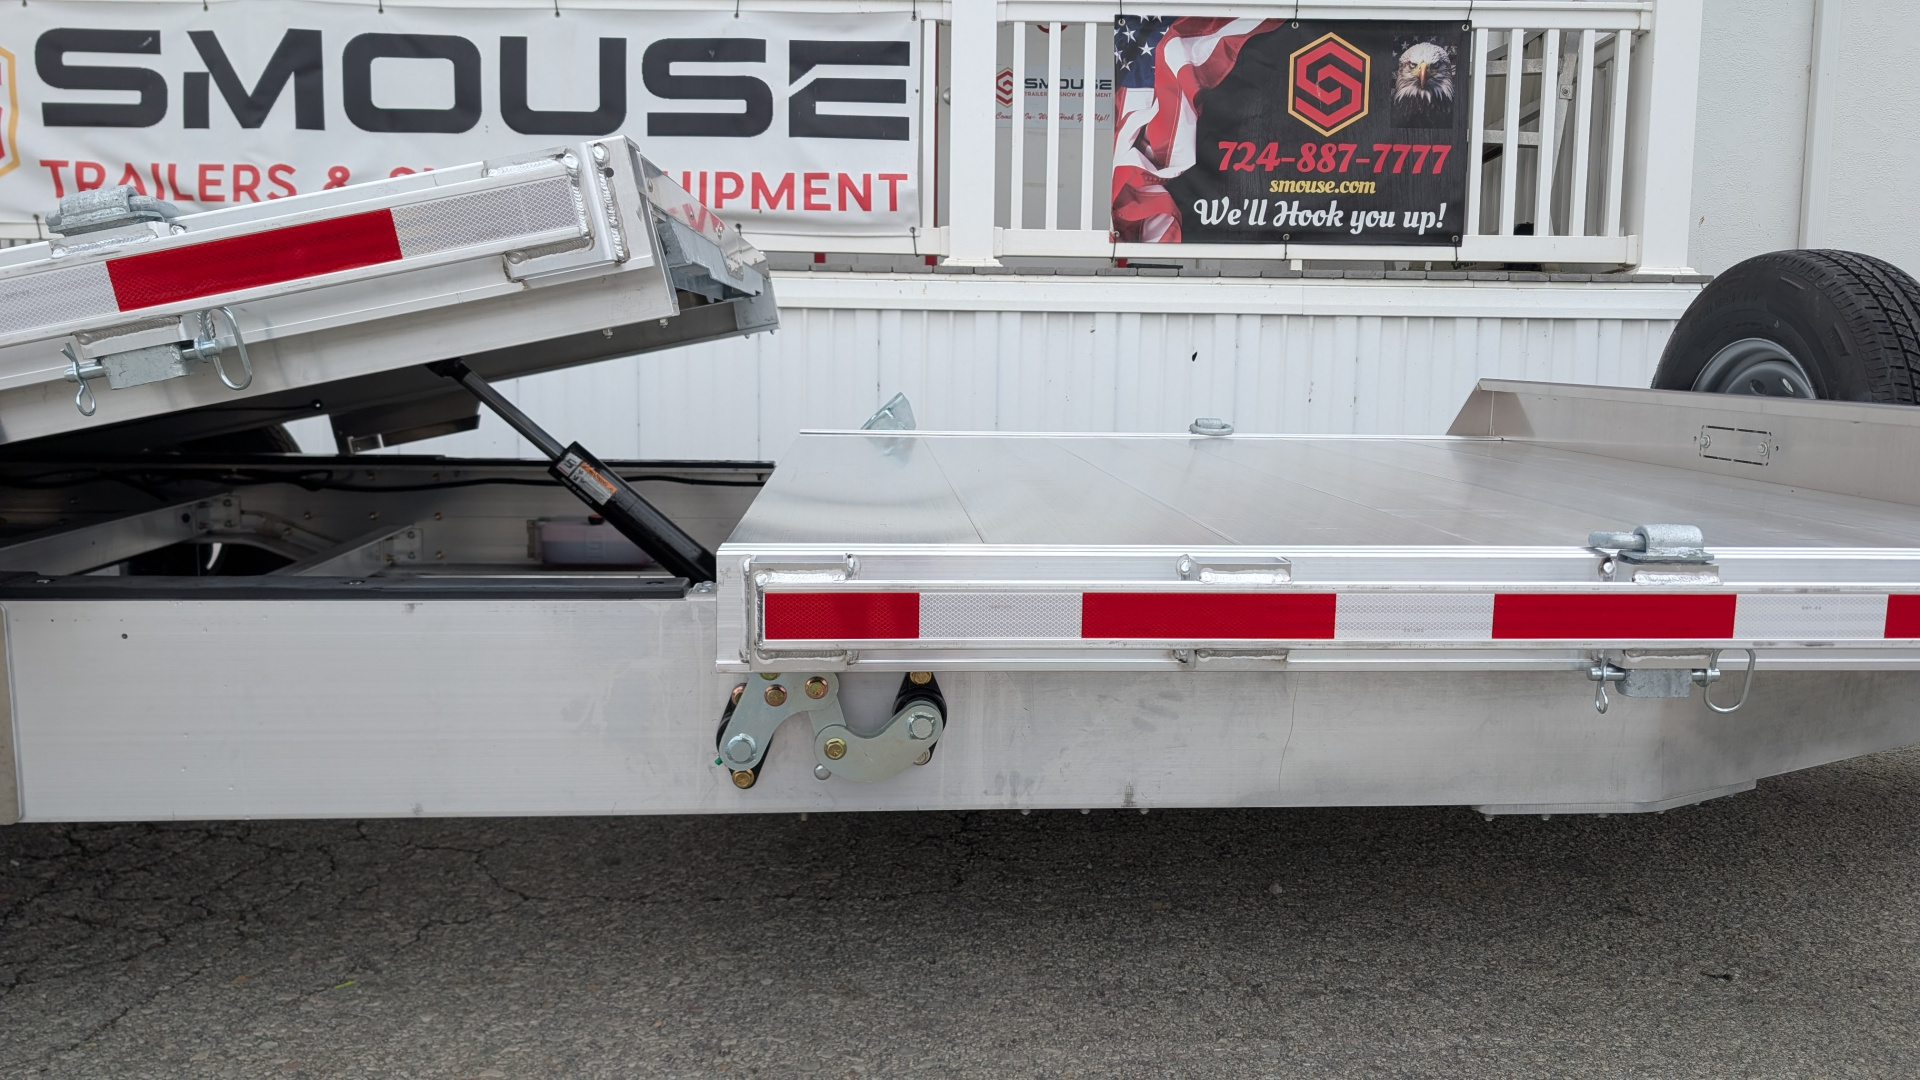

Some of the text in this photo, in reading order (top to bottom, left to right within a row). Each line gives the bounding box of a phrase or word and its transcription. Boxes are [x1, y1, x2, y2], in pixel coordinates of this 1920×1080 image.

[35, 28, 910, 138] SMOUSE
[1024, 78, 1112, 90] SMOUE
[1218, 140, 1452, 175] 724-887-7777
[40, 159, 297, 202] TRAILERS
[1269, 178, 1376, 194] smouse.com
[1193, 196, 1447, 236] We'll Hook you up!
